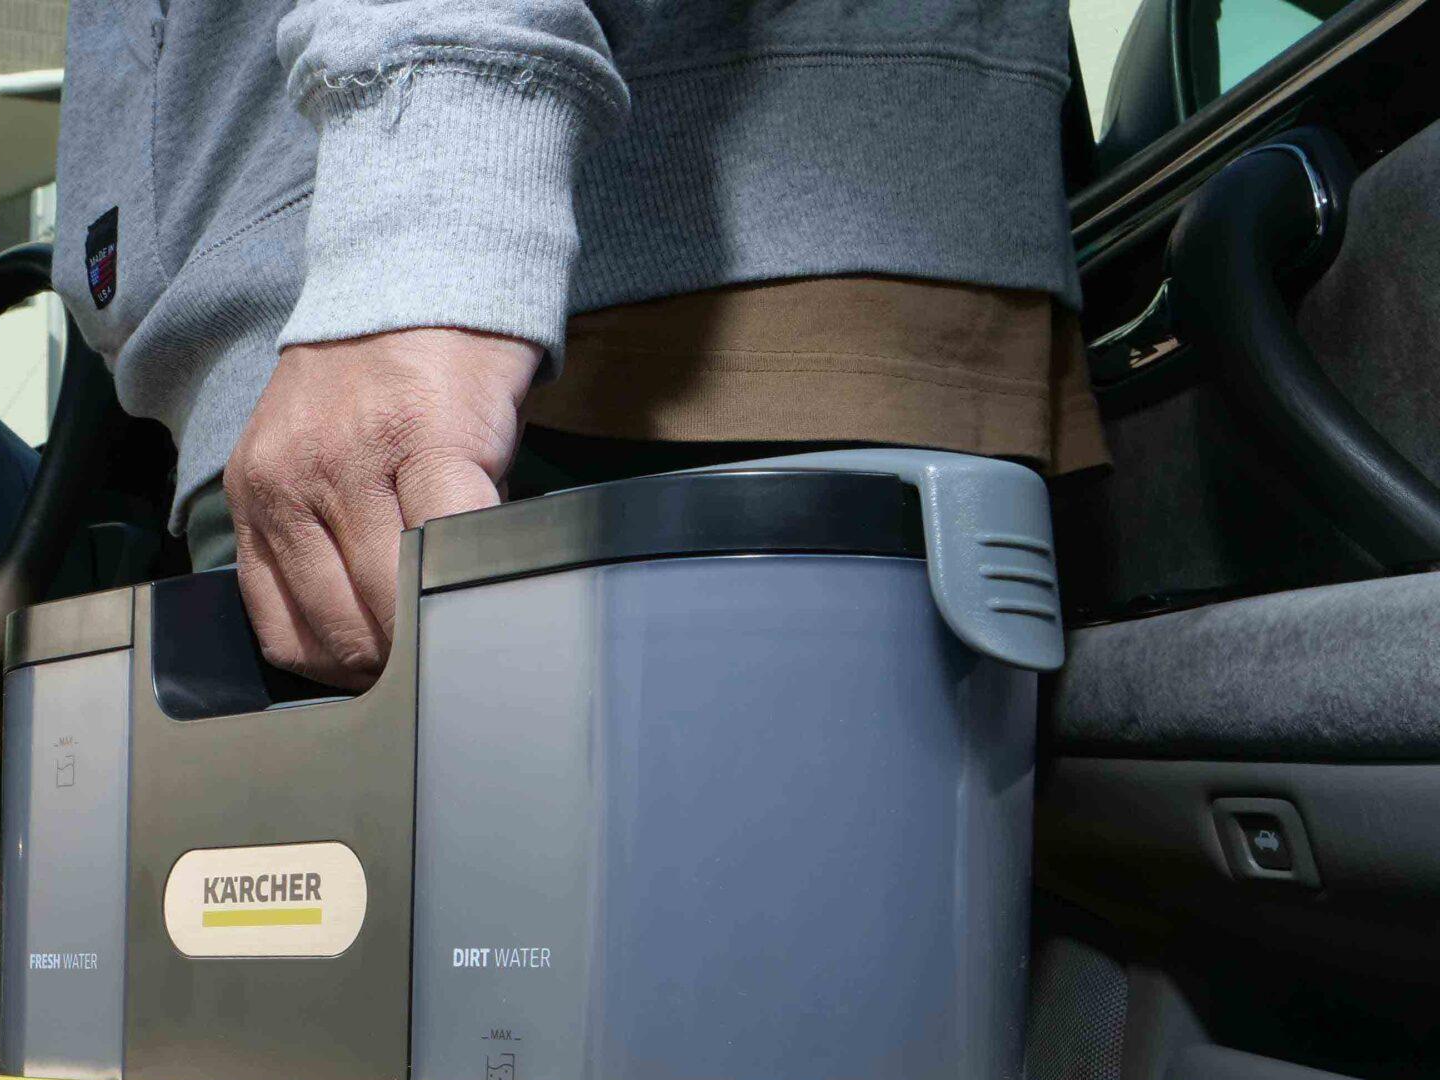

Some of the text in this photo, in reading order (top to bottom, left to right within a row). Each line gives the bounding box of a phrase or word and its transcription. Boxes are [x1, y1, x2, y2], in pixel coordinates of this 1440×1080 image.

[203, 872, 322, 904] KÄRCHER
[29, 953, 98, 969] FRESH WATER
[453, 948, 551, 968] DIRT WATER
[490, 1029, 512, 1040] MAX
